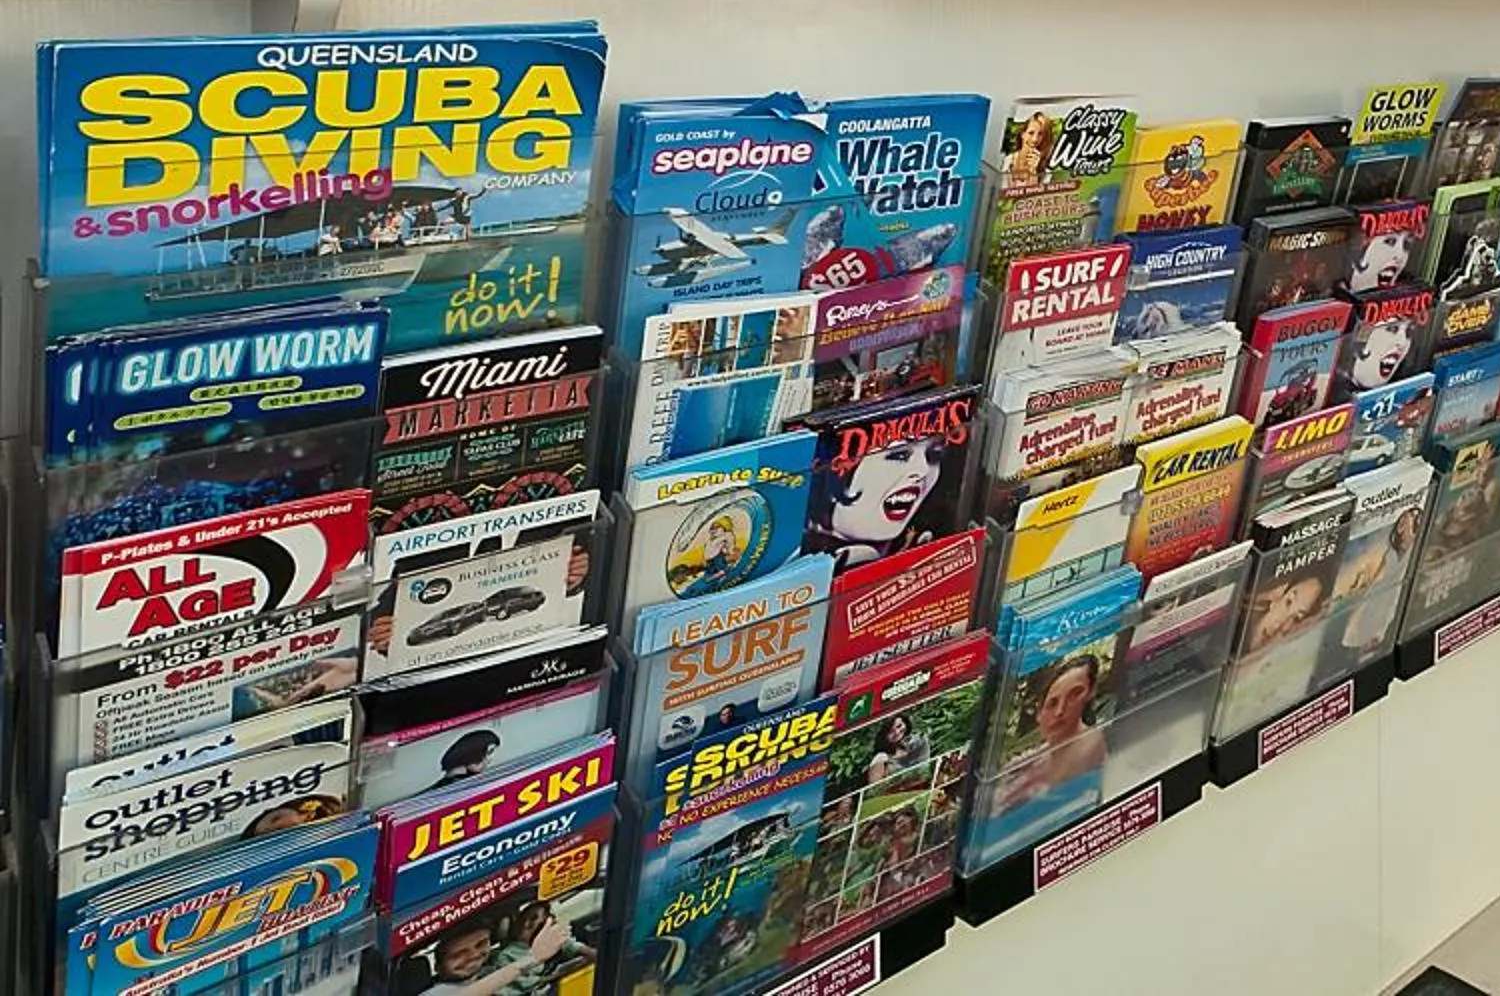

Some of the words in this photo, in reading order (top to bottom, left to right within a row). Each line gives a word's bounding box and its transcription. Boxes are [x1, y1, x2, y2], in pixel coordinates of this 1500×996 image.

[257, 44, 479, 69] QUEENSLAND
[78, 64, 582, 143] SCUBA
[1064, 104, 1125, 132] Classy
[1369, 87, 1438, 113] GLOW
[839, 115, 932, 135] COOLANGATTA
[1362, 111, 1428, 133] WORMS
[86, 116, 573, 207] DIVING
[653, 137, 813, 175] seaplane
[839, 132, 960, 177] Whale
[1050, 130, 1124, 171] Wine
[106, 165, 394, 237] snorkelling
[483, 170, 578, 191] COMPANY
[1034, 257, 1106, 292] SURF
[1146, 253, 1173, 273] HIGH
[1175, 245, 1227, 266] COUNTRY
[450, 270, 497, 308] do
[502, 263, 542, 301] it
[1012, 282, 1114, 325] RENTAL
[1277, 316, 1342, 342] BUGGY
[120, 341, 248, 395] GLOW
[254, 323, 376, 377] WORM
[420, 345, 568, 399] Miami
[400, 381, 578, 438] MARKETTA
[1136, 383, 1204, 416] Adrenaline
[1141, 395, 1196, 430] charged
[1020, 412, 1096, 451] Adrenaline
[1026, 429, 1089, 465] charged
[1273, 410, 1348, 450] LIMO
[1190, 440, 1243, 472] RENTAL
[658, 472, 725, 500] Learn
[730, 468, 752, 481] to
[1041, 493, 1079, 516] Hertz
[101, 540, 174, 566] P-Plates
[177, 534, 191, 547] &
[195, 525, 241, 543] Under
[282, 503, 352, 524] Accepted
[388, 523, 478, 555] AIRPORT
[483, 500, 588, 533] TRANSFERS
[1281, 514, 1342, 546] MASSAGE
[1275, 544, 1336, 578] PAMPER
[96, 558, 217, 610] ALL
[127, 578, 256, 637] AGE
[671, 599, 769, 647] LEARN
[778, 585, 814, 610] TO
[162, 633, 225, 658] 1800
[232, 618, 275, 639] ALL
[666, 608, 812, 693] SURF
[97, 682, 157, 708] From
[163, 660, 224, 690] $22
[232, 644, 282, 673] per
[288, 627, 341, 653] Day
[135, 650, 202, 675] 1800
[694, 705, 838, 767] SCUBA
[83, 761, 326, 864] shopping
[84, 768, 234, 829] outlet
[408, 795, 505, 861] JET
[517, 757, 601, 814] SKI
[679, 811, 699, 825] NO
[701, 783, 770, 817] EXPERIENCE
[81, 844, 171, 884] CENTRE
[173, 820, 241, 853] GUIDE
[441, 811, 577, 876] Economy
[547, 849, 590, 876] $29
[165, 872, 313, 953] JET
[405, 922, 442, 945] Late
[445, 890, 496, 924] Model
[500, 871, 534, 893] Cars
[665, 889, 695, 914] do
